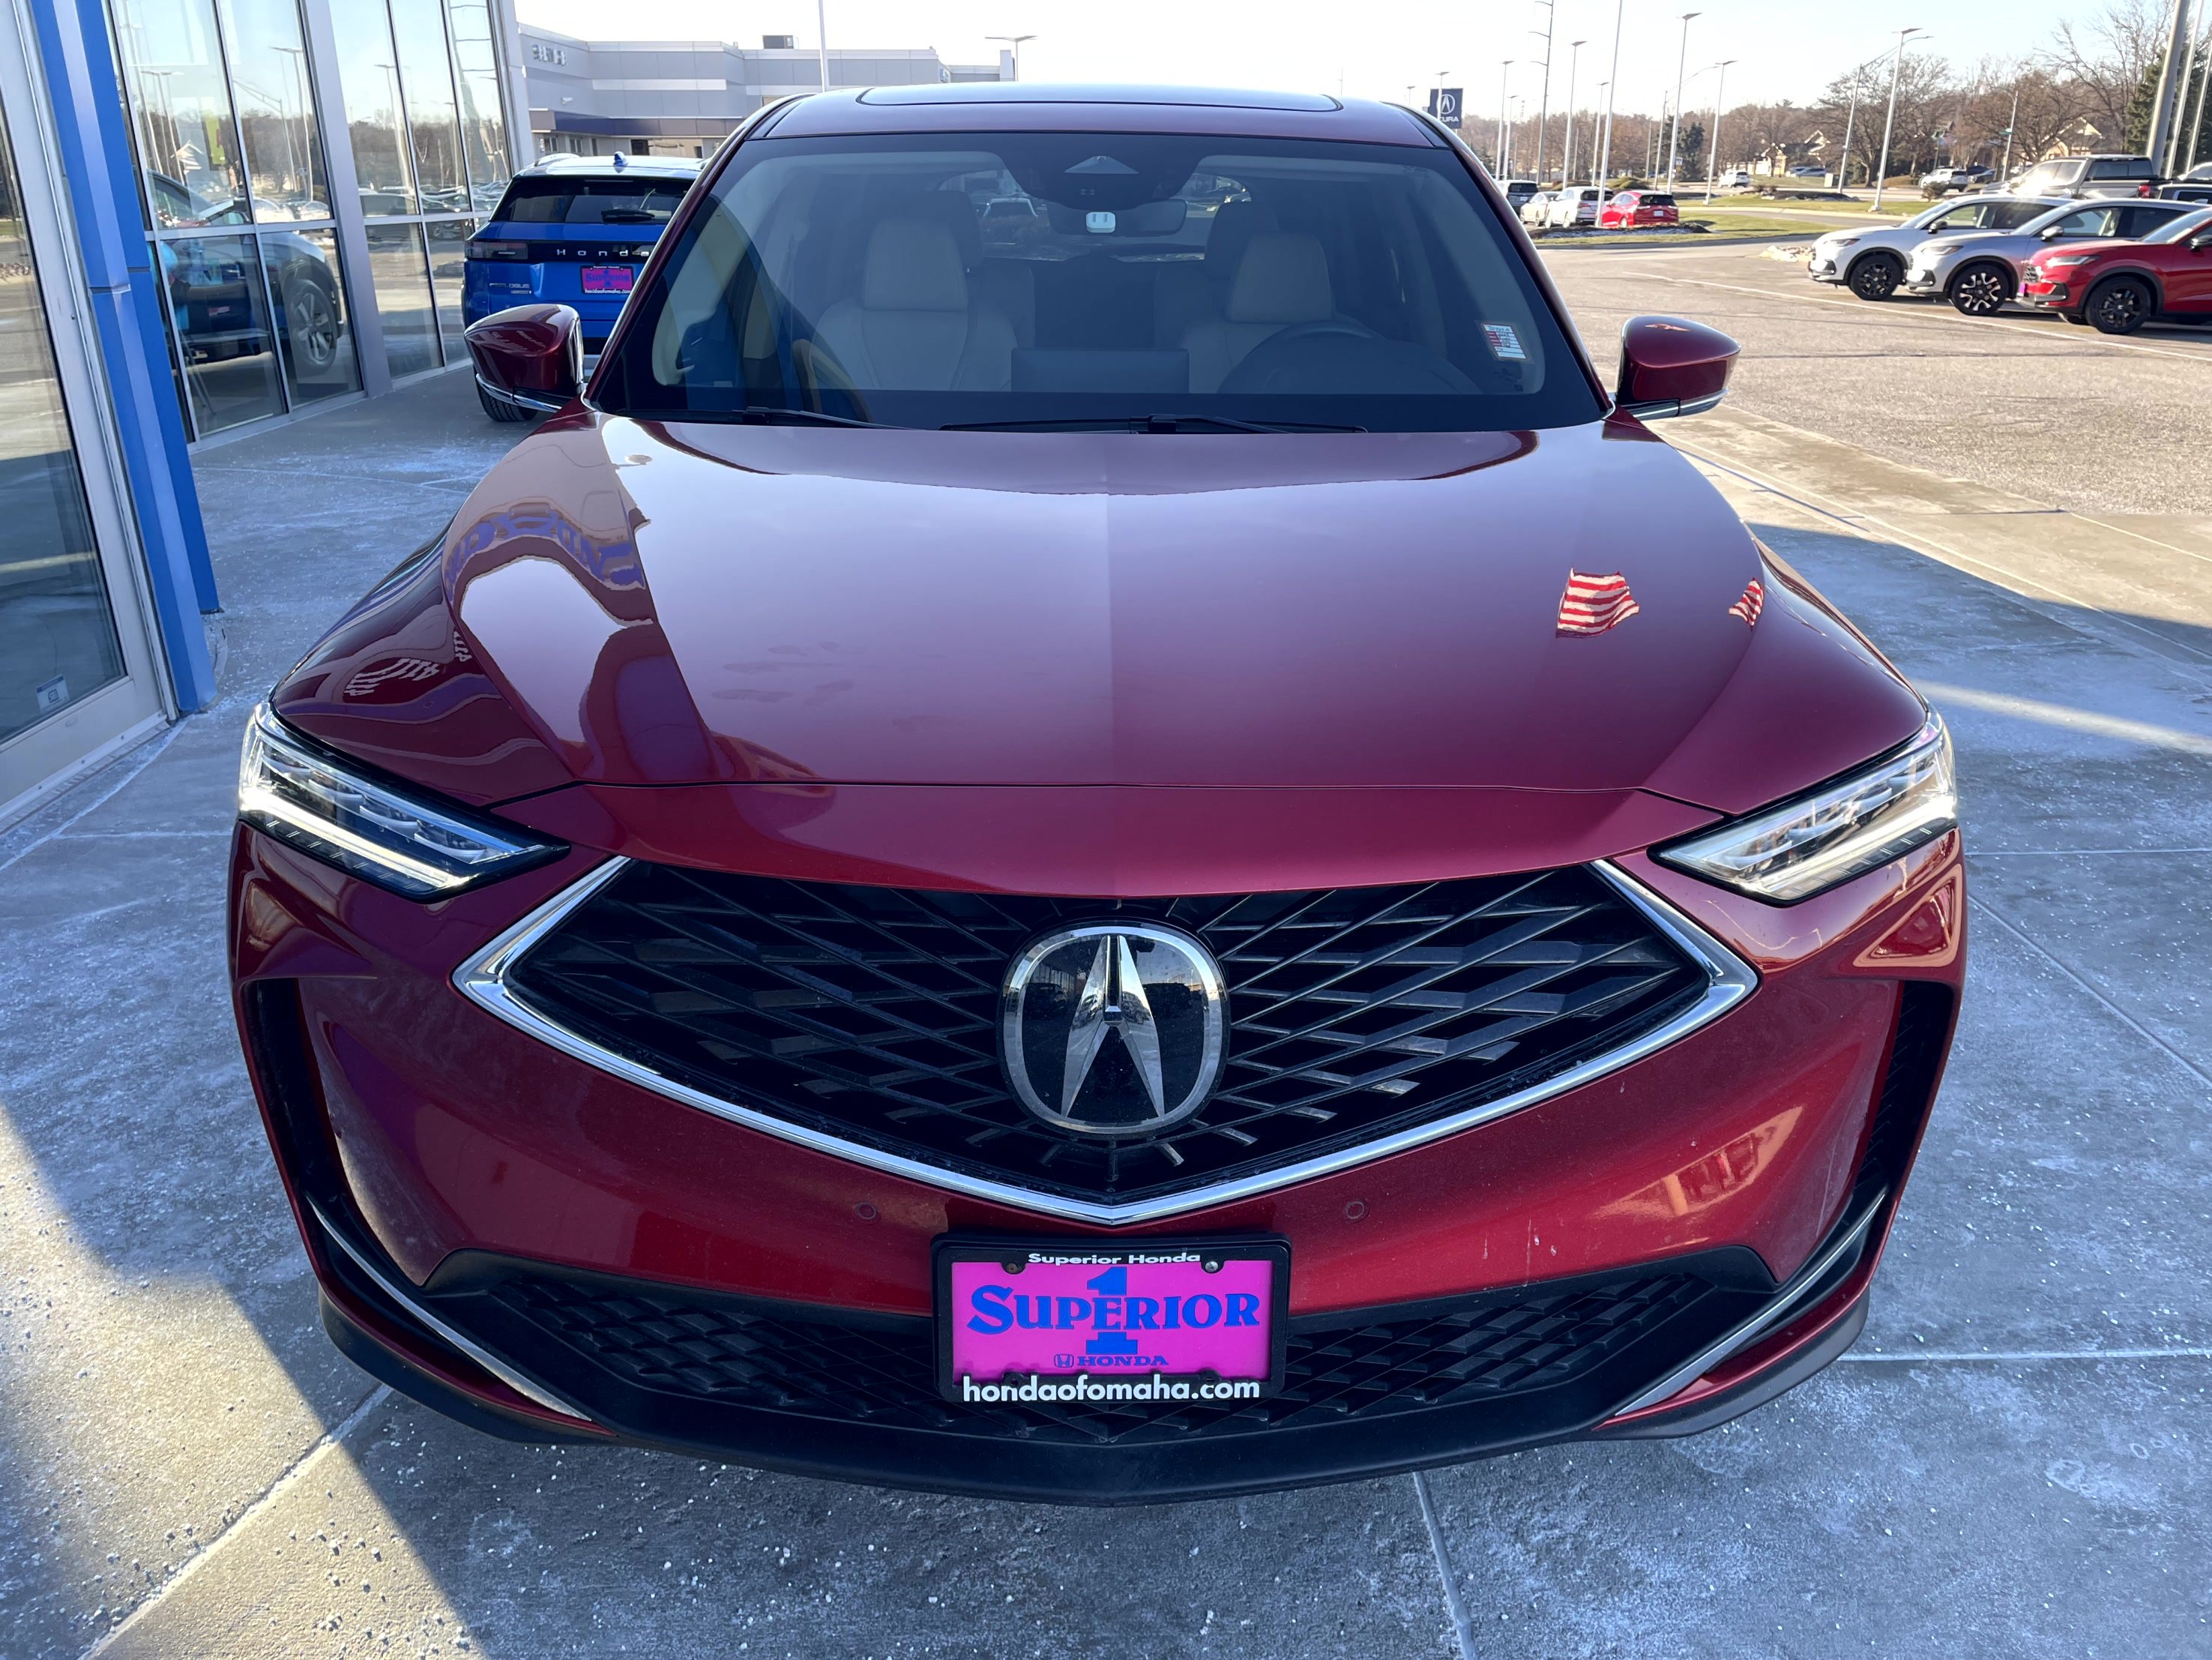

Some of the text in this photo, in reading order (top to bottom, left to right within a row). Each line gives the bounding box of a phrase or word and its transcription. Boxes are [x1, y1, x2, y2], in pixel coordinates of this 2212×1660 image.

[1028, 1253, 1201, 1266] Superior Honda
[967, 1284, 1260, 1335] SUPERIOR
[1077, 1355, 1169, 1366] HONDA
[963, 1374, 1259, 1402] hondaofomaha.com
